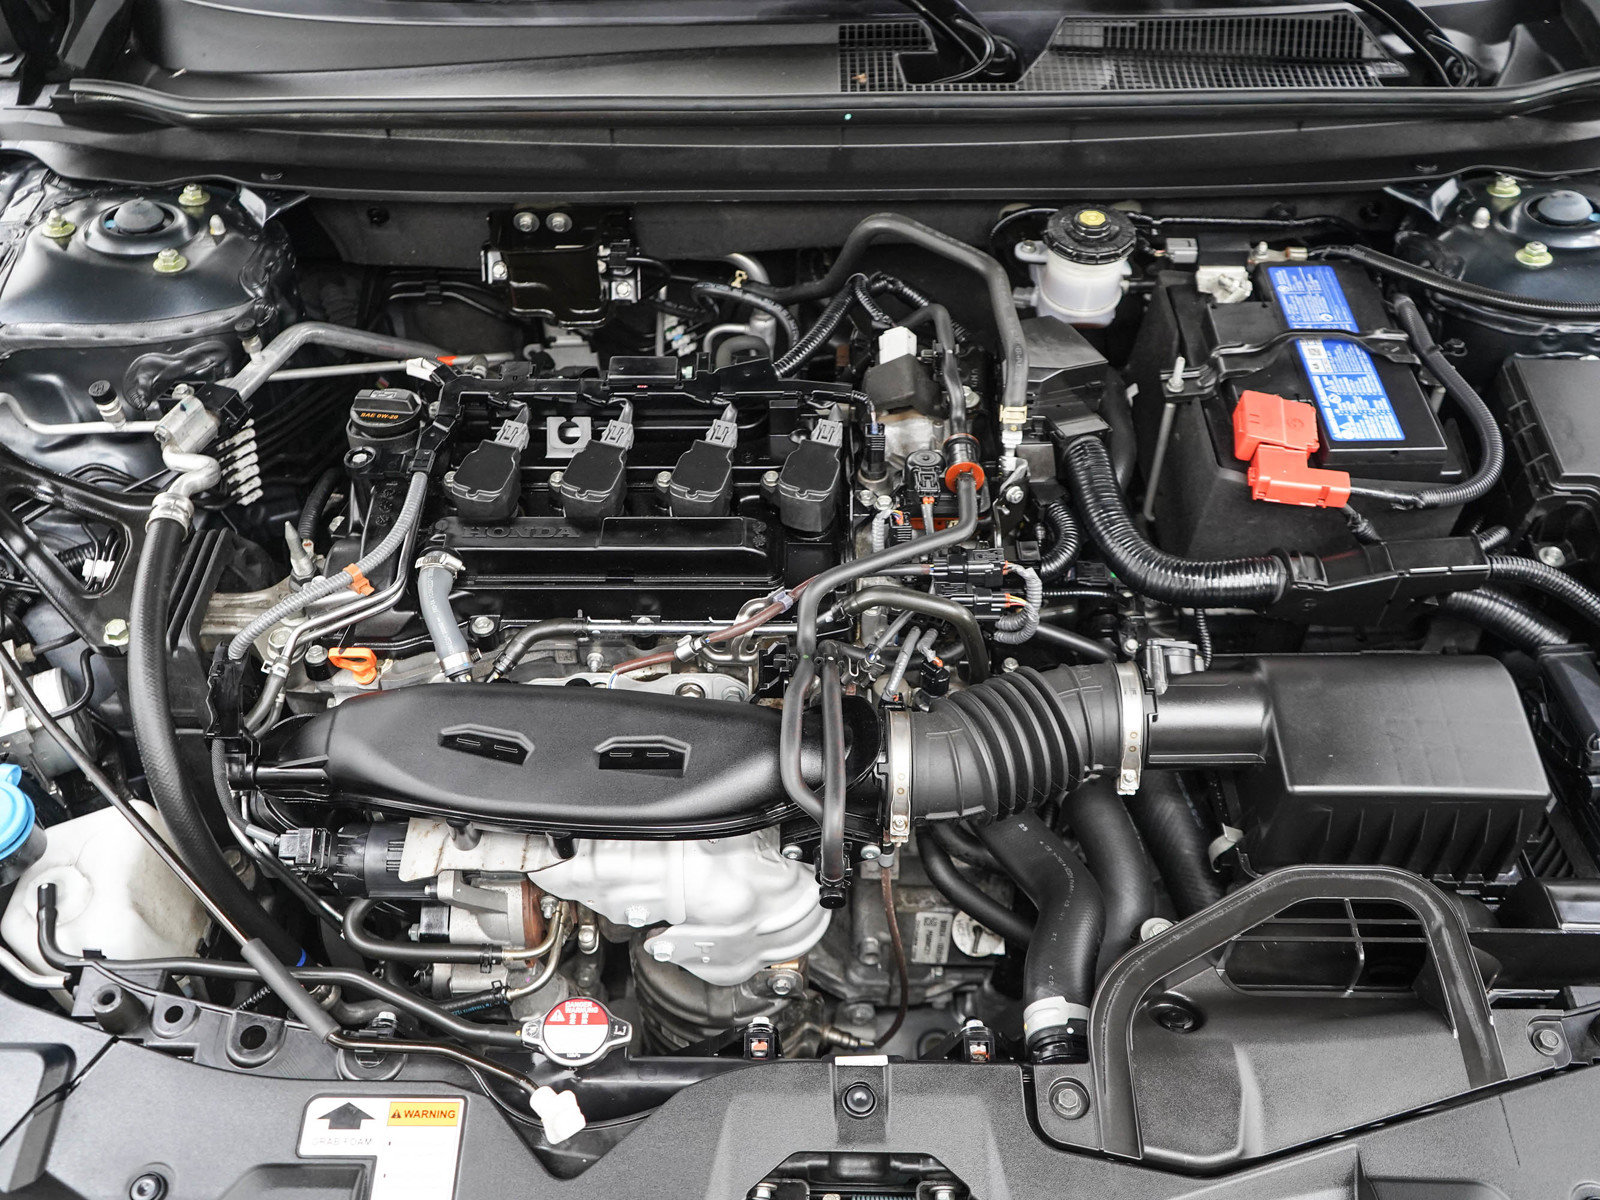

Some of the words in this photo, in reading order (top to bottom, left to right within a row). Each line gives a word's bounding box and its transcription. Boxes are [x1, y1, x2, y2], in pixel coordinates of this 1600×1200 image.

[461, 526, 580, 539] HONDA
[565, 1006, 599, 1014] WARNING
[403, 1109, 456, 1119] WARNING
